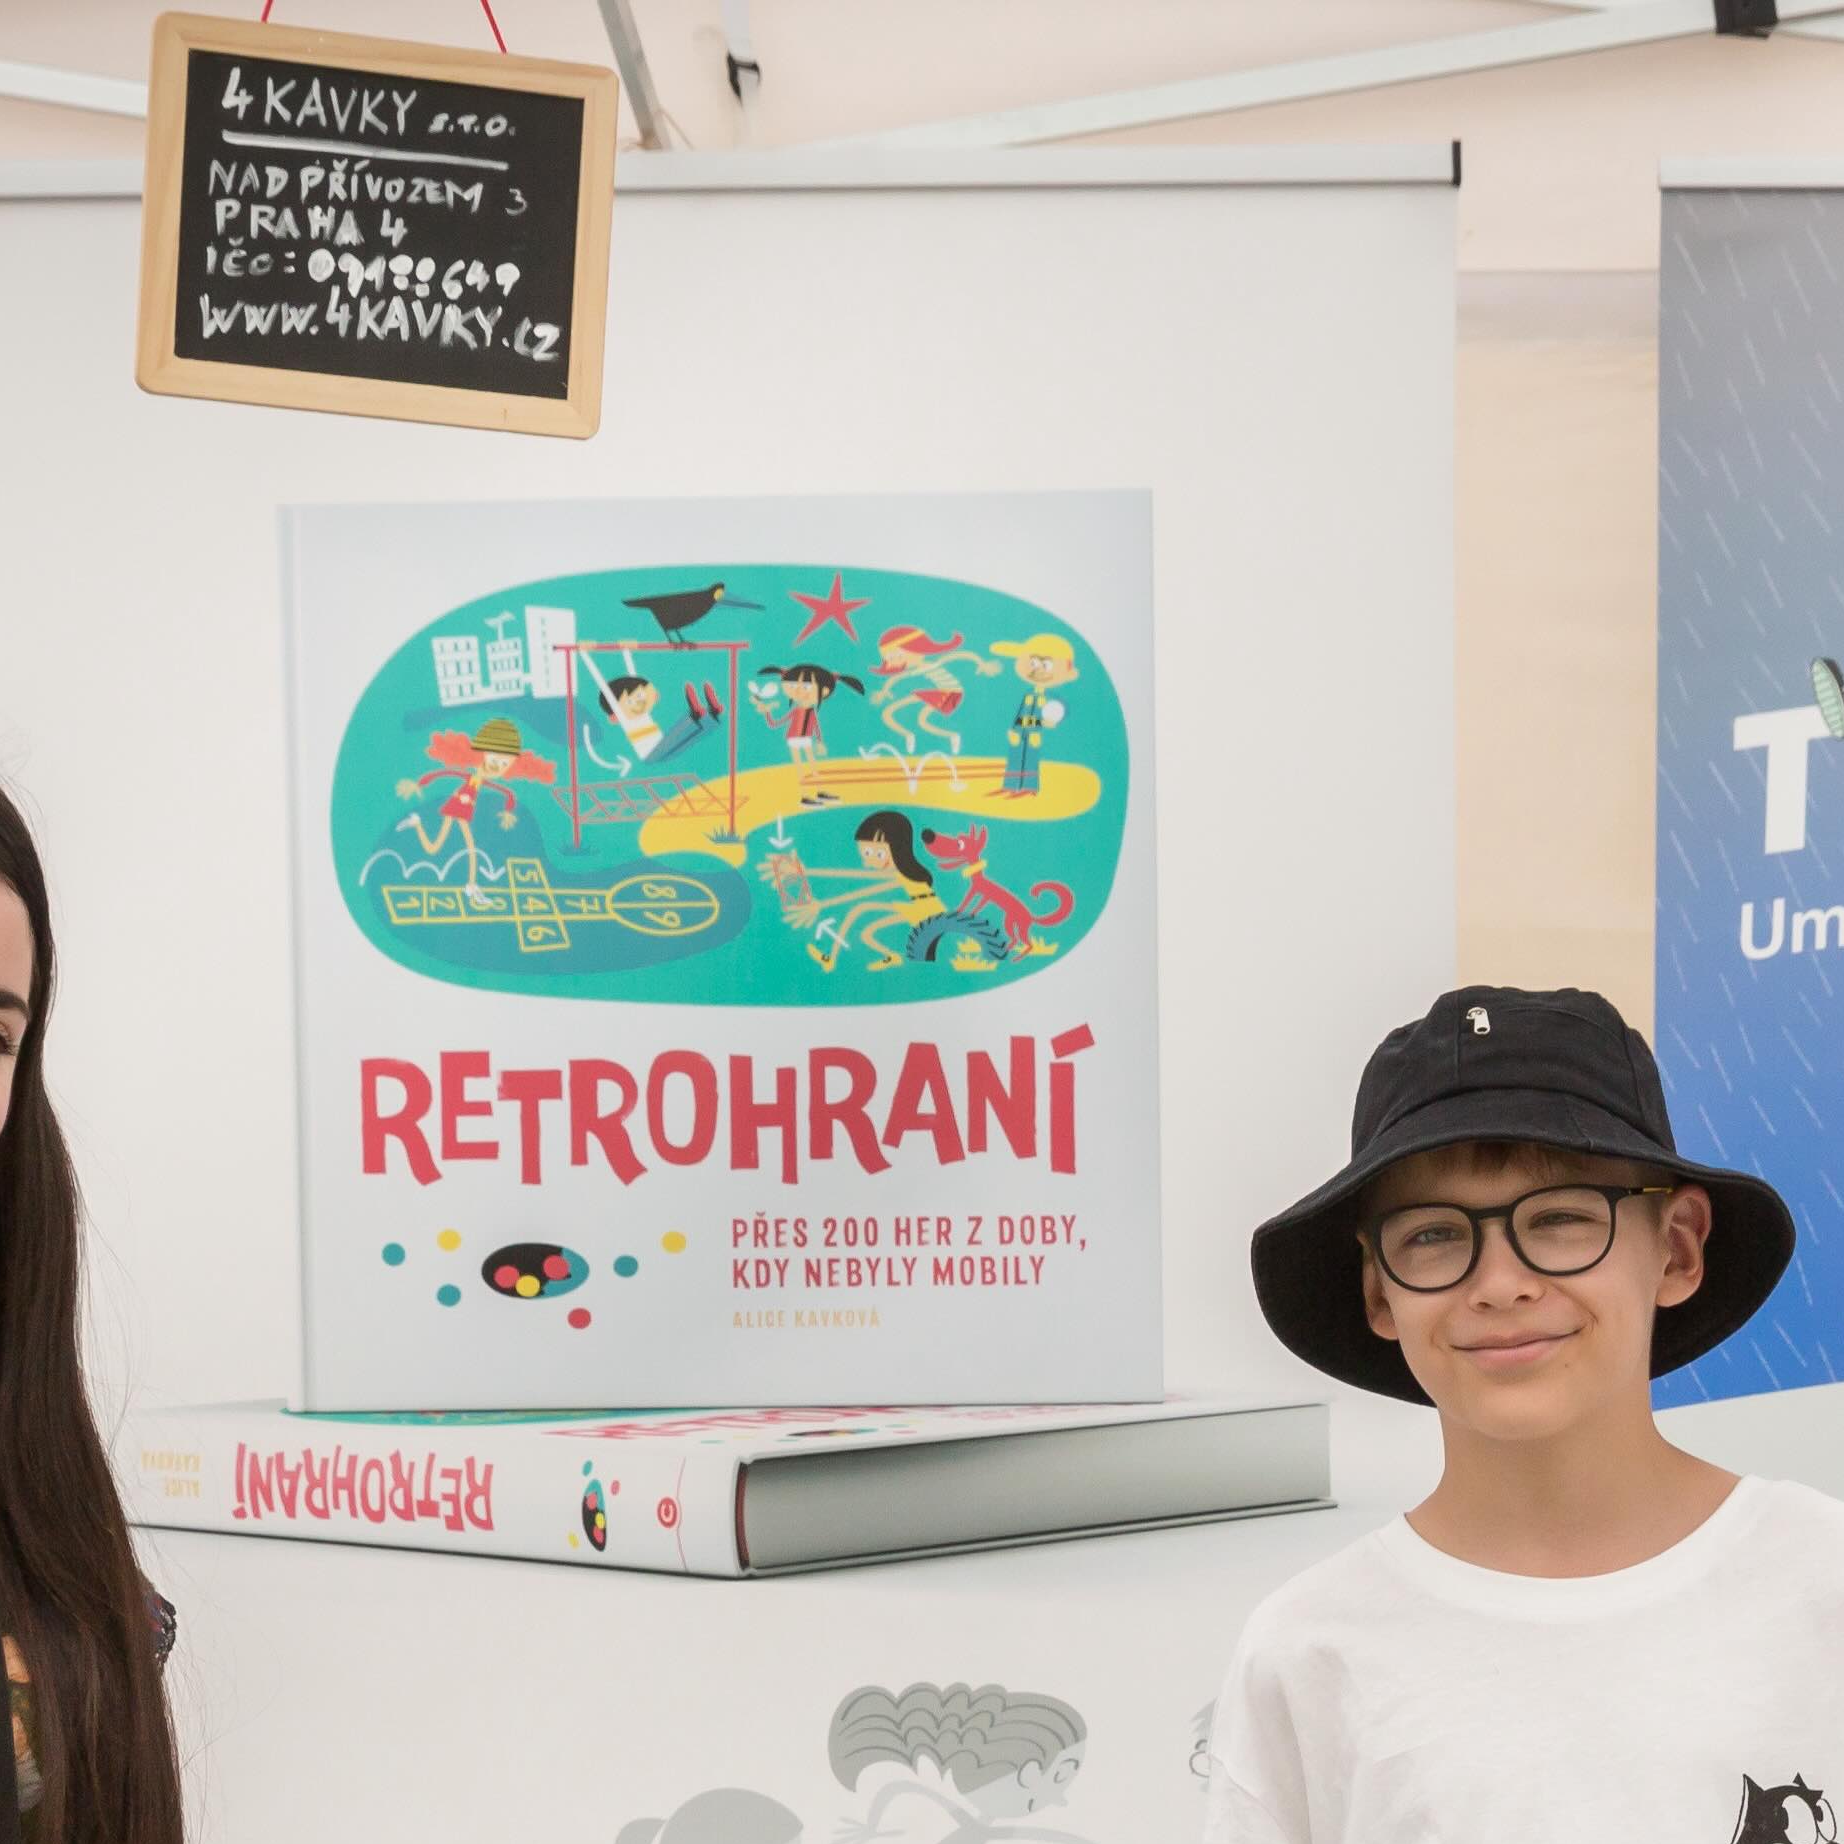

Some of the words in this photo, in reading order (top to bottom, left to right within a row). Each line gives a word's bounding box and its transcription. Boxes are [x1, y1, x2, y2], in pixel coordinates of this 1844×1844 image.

[222, 66, 254, 120] 4
[262, 75, 417, 135] KAVKY
[208, 159, 287, 197] NAD
[506, 187, 529, 216] 3
[215, 198, 365, 247] PRAHA
[380, 208, 408, 247] 4
[360, 1023, 1096, 1187] RETROHRANÍ
[732, 1211, 808, 1249] PŘES
[823, 1216, 879, 1247] 200
[894, 1215, 953, 1246] HER
[966, 1215, 983, 1246] Z
[998, 1214, 1087, 1252] DOBY,
[732, 1257, 790, 1289] KDY
[805, 1256, 917, 1288] NEBYLY
[932, 1255, 1045, 1288] MOBILY
[732, 1309, 785, 1329] ALICE
[231, 1441, 495, 1533] RETROHRANÍ
